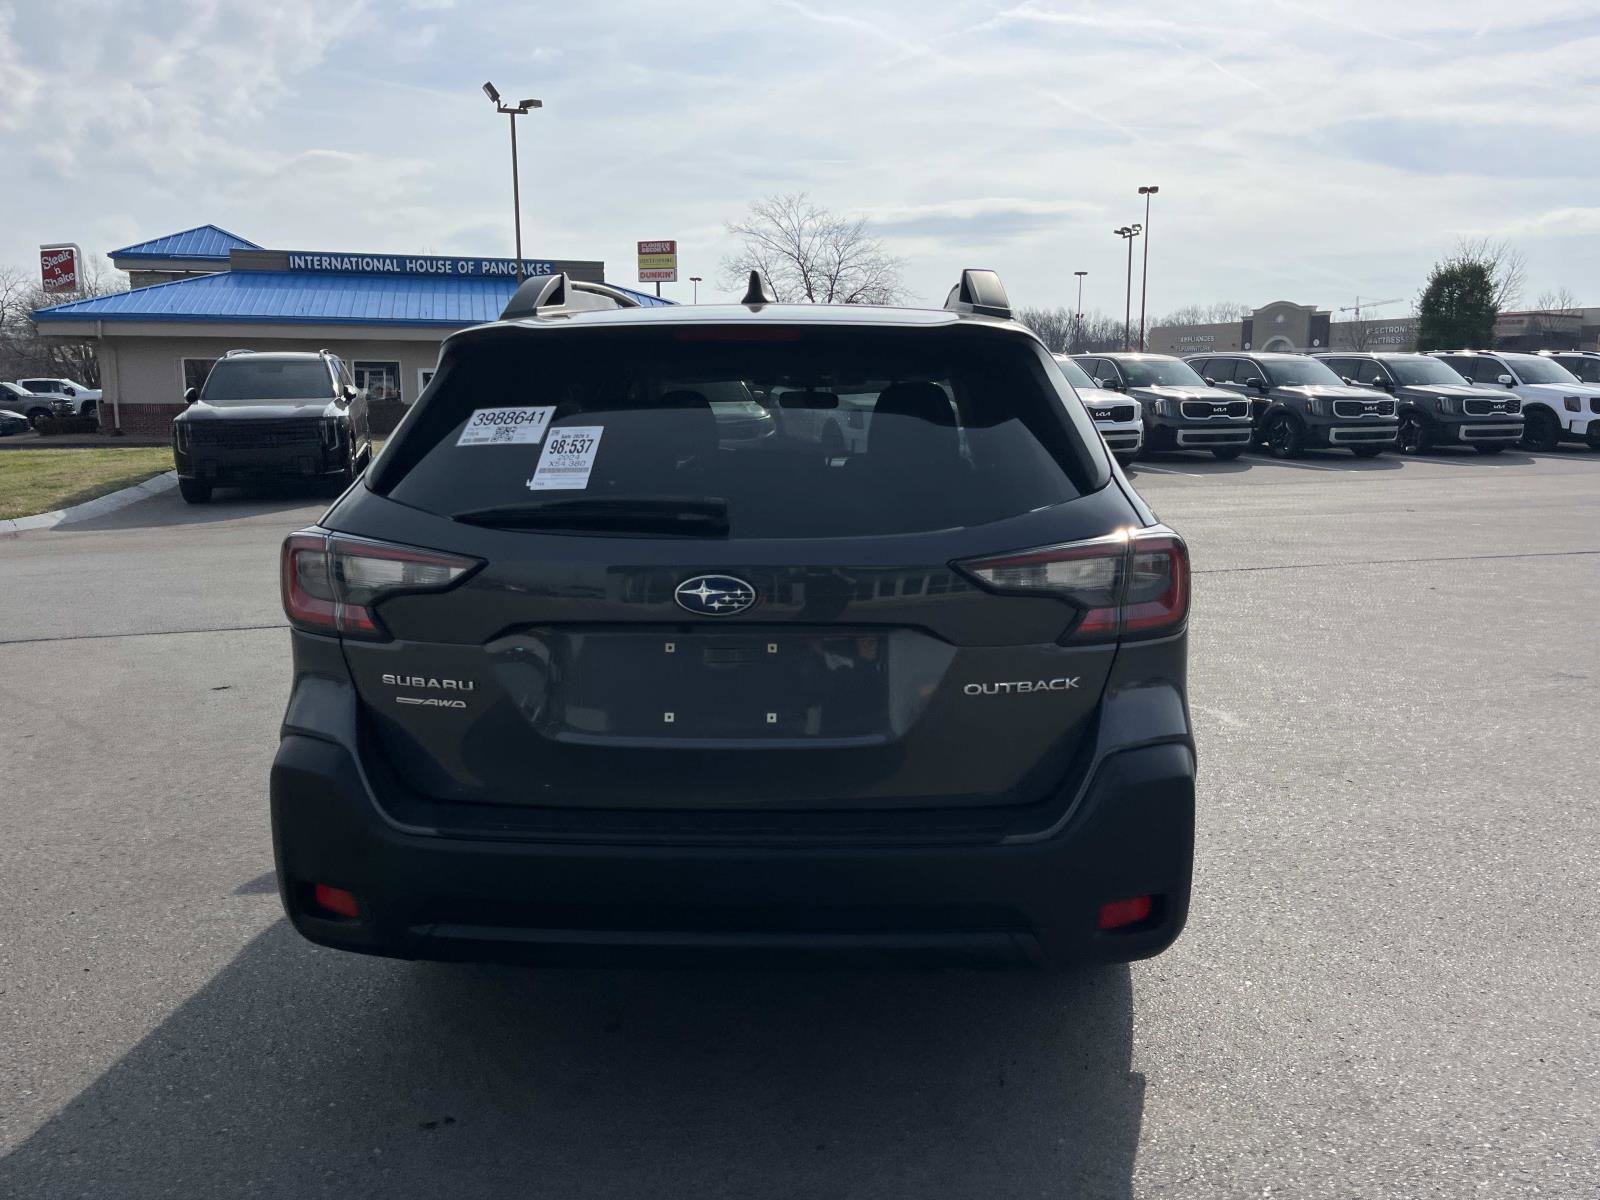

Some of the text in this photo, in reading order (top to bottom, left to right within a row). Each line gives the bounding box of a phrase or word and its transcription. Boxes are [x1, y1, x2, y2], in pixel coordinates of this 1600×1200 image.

[41, 250, 71, 270] Steak
[289, 255, 551, 276] INTERNATIONAL HOUSE OF PANCAKES
[473, 410, 546, 426] 3988641
[549, 439, 594, 454] 98:537
[382, 674, 474, 690] SUBARU
[963, 676, 1081, 695] OUTBACK
[423, 698, 467, 708] AWD
